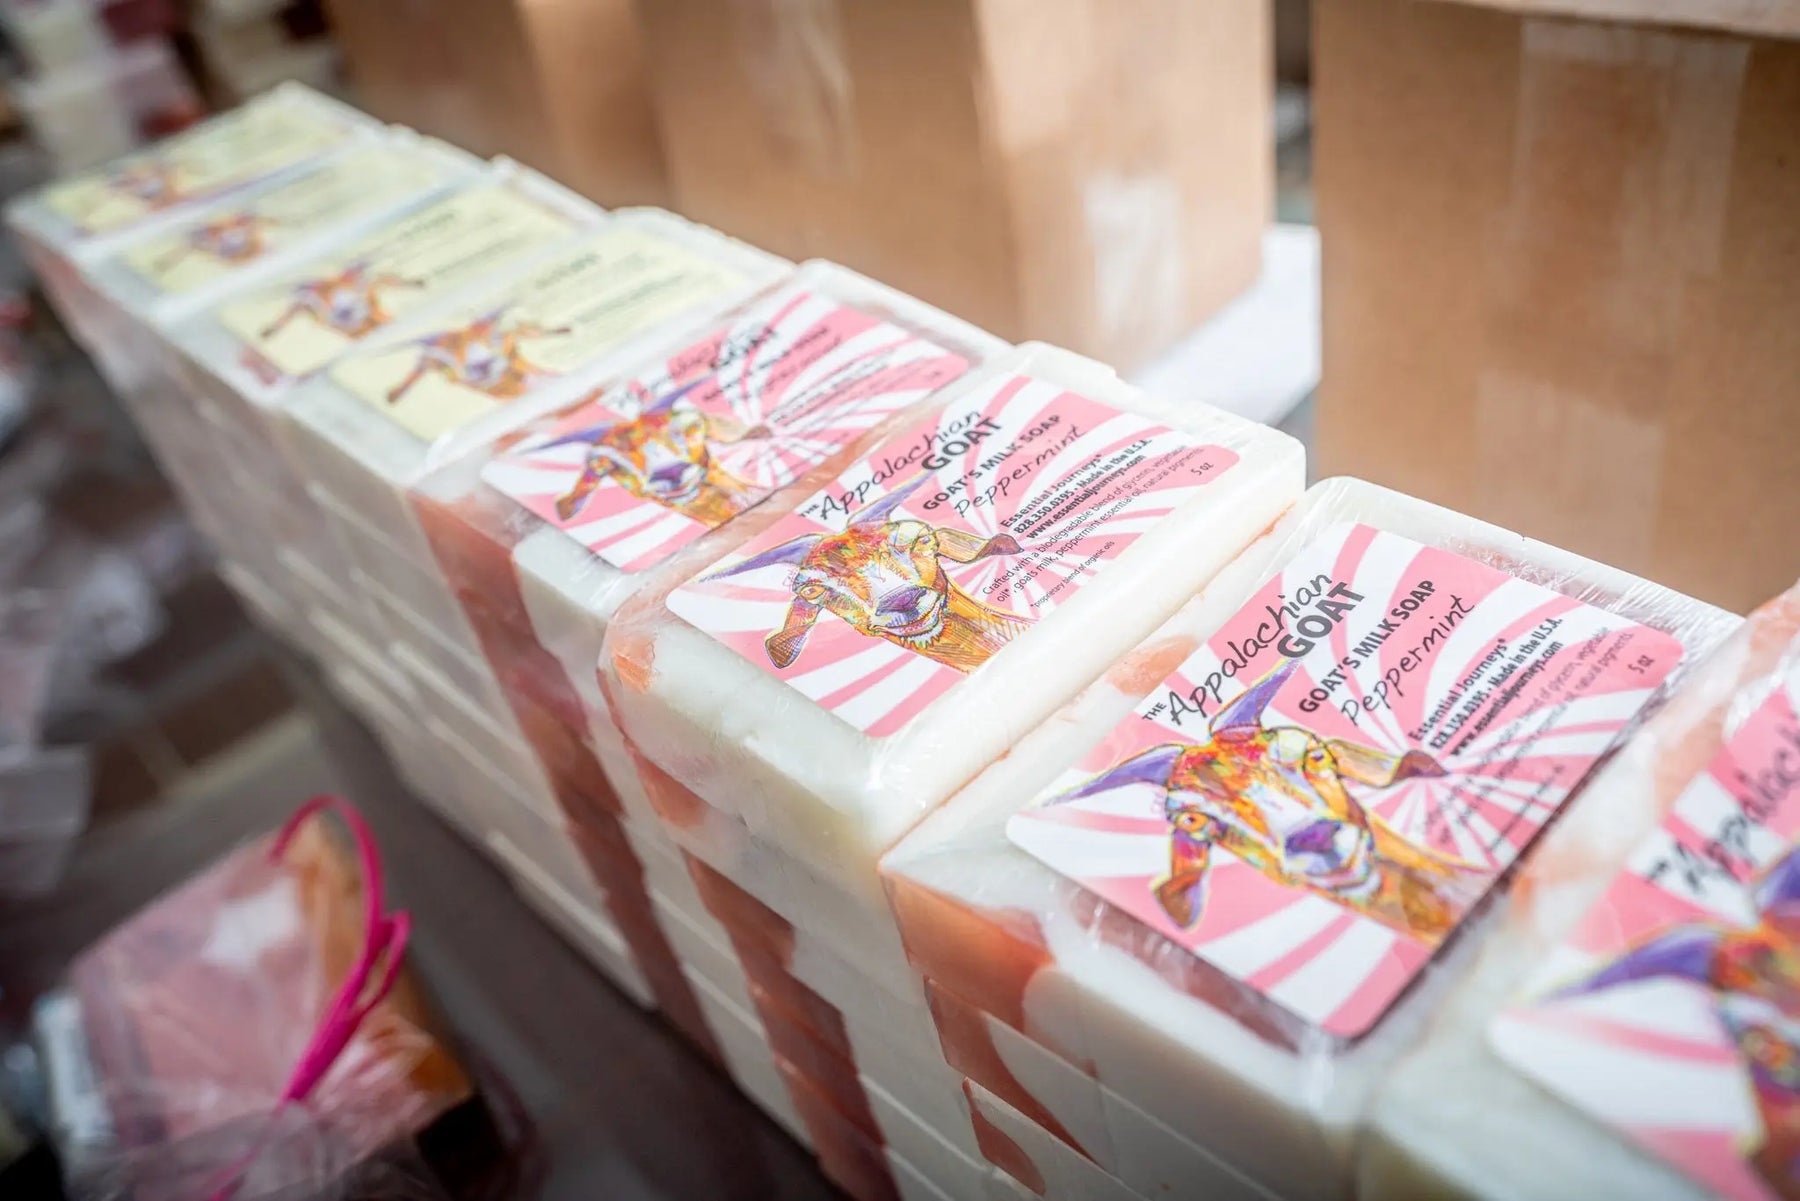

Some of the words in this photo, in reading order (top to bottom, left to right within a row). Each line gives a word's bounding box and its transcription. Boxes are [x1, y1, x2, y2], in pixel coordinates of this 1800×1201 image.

[820, 410, 981, 520] Appalachian
[921, 416, 1002, 470] GOAT
[923, 469, 983, 510] GOAT'S
[980, 444, 1021, 471] MILK
[1020, 414, 1060, 442] SOAP
[954, 424, 1086, 518] Peppermint
[800, 503, 819, 518] THE
[1000, 490, 1052, 528] Essential
[1014, 489, 1075, 534] 828.350.0395
[1077, 470, 1104, 488] Made
[1101, 463, 1114, 472] in
[1110, 454, 1128, 465] the
[1026, 455, 1146, 539] www.essentialjourneys.com
[982, 569, 1015, 595] Crafted
[1012, 556, 1034, 573] with
[1036, 510, 1094, 553] biodegradable
[1089, 493, 1115, 511] blend
[1113, 486, 1124, 495] of
[1014, 571, 1038, 590] goats
[1036, 555, 1058, 572] milk,
[1056, 519, 1101, 557] peppermint
[1101, 495, 1133, 521] essential
[1085, 549, 1104, 566] organic
[1169, 574, 1332, 725] Appalachian
[1277, 581, 1365, 658] GOAT
[1299, 656, 1361, 713] GOAT'S
[1352, 618, 1401, 658] MILK
[1391, 580, 1436, 620] SOAP
[1519, 637, 1541, 656] the
[1531, 618, 1563, 641] U.S.A.
[1341, 594, 1475, 726] Peppermint
[1488, 663, 1518, 688] Made
[1513, 653, 1527, 665] in
[1142, 702, 1167, 721] THE
[1408, 689, 1462, 741] Essential
